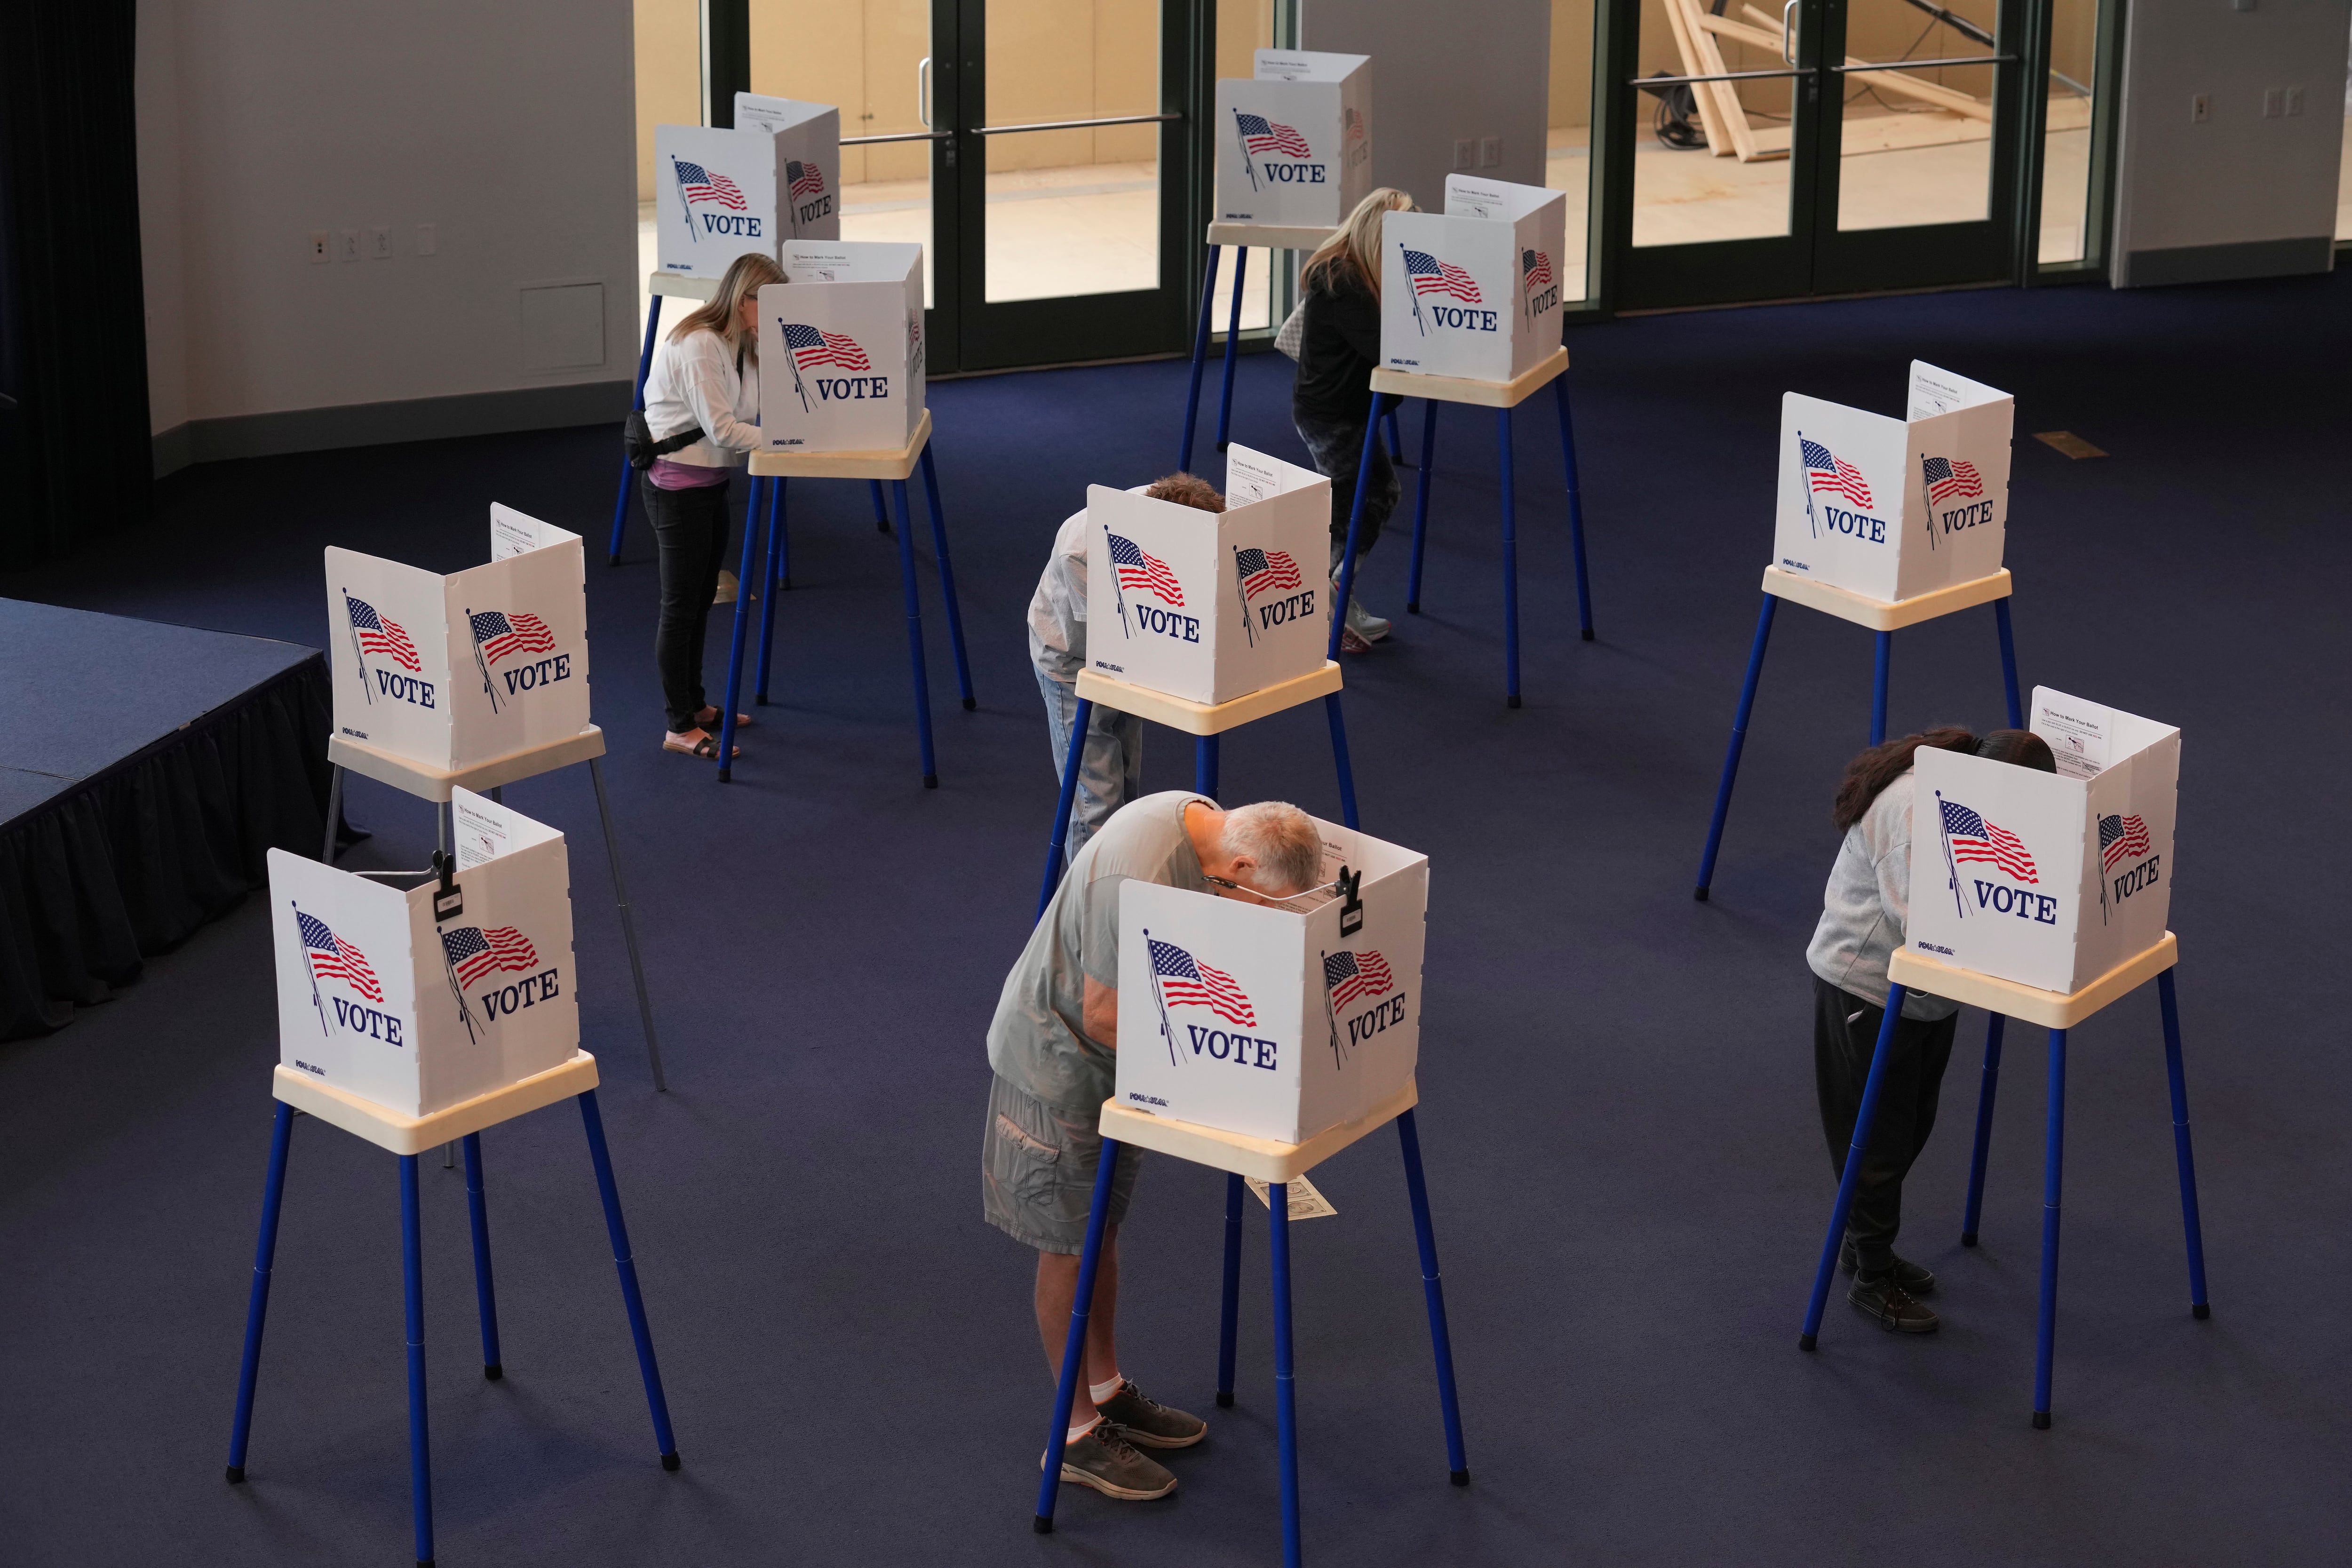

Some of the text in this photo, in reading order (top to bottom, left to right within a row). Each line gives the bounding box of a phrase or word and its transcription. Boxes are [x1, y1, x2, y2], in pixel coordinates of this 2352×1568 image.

[1264, 164, 1325, 183] VOTE
[703, 214, 761, 237] VOTE
[800, 195, 831, 225] VOTE
[1432, 306, 1496, 331] VOTE
[1533, 285, 1557, 318] VOTE
[817, 377, 887, 400] VOTE
[1825, 506, 1885, 543] VOTE
[1943, 500, 1993, 534] VOTE
[1136, 605, 1199, 643] VOTE
[1260, 590, 1313, 629] VOTE
[376, 669, 434, 708] VOTE
[504, 653, 570, 695] VOTE
[1328, 842, 1342, 851] Ballot
[2114, 855, 2159, 904] VOTE
[1974, 880, 2056, 925] VOTE
[482, 968, 558, 1021] VOTE
[333, 996, 402, 1047] VOTE
[1348, 992, 1405, 1046] VOTE
[1187, 1025, 1276, 1070] VOTE
